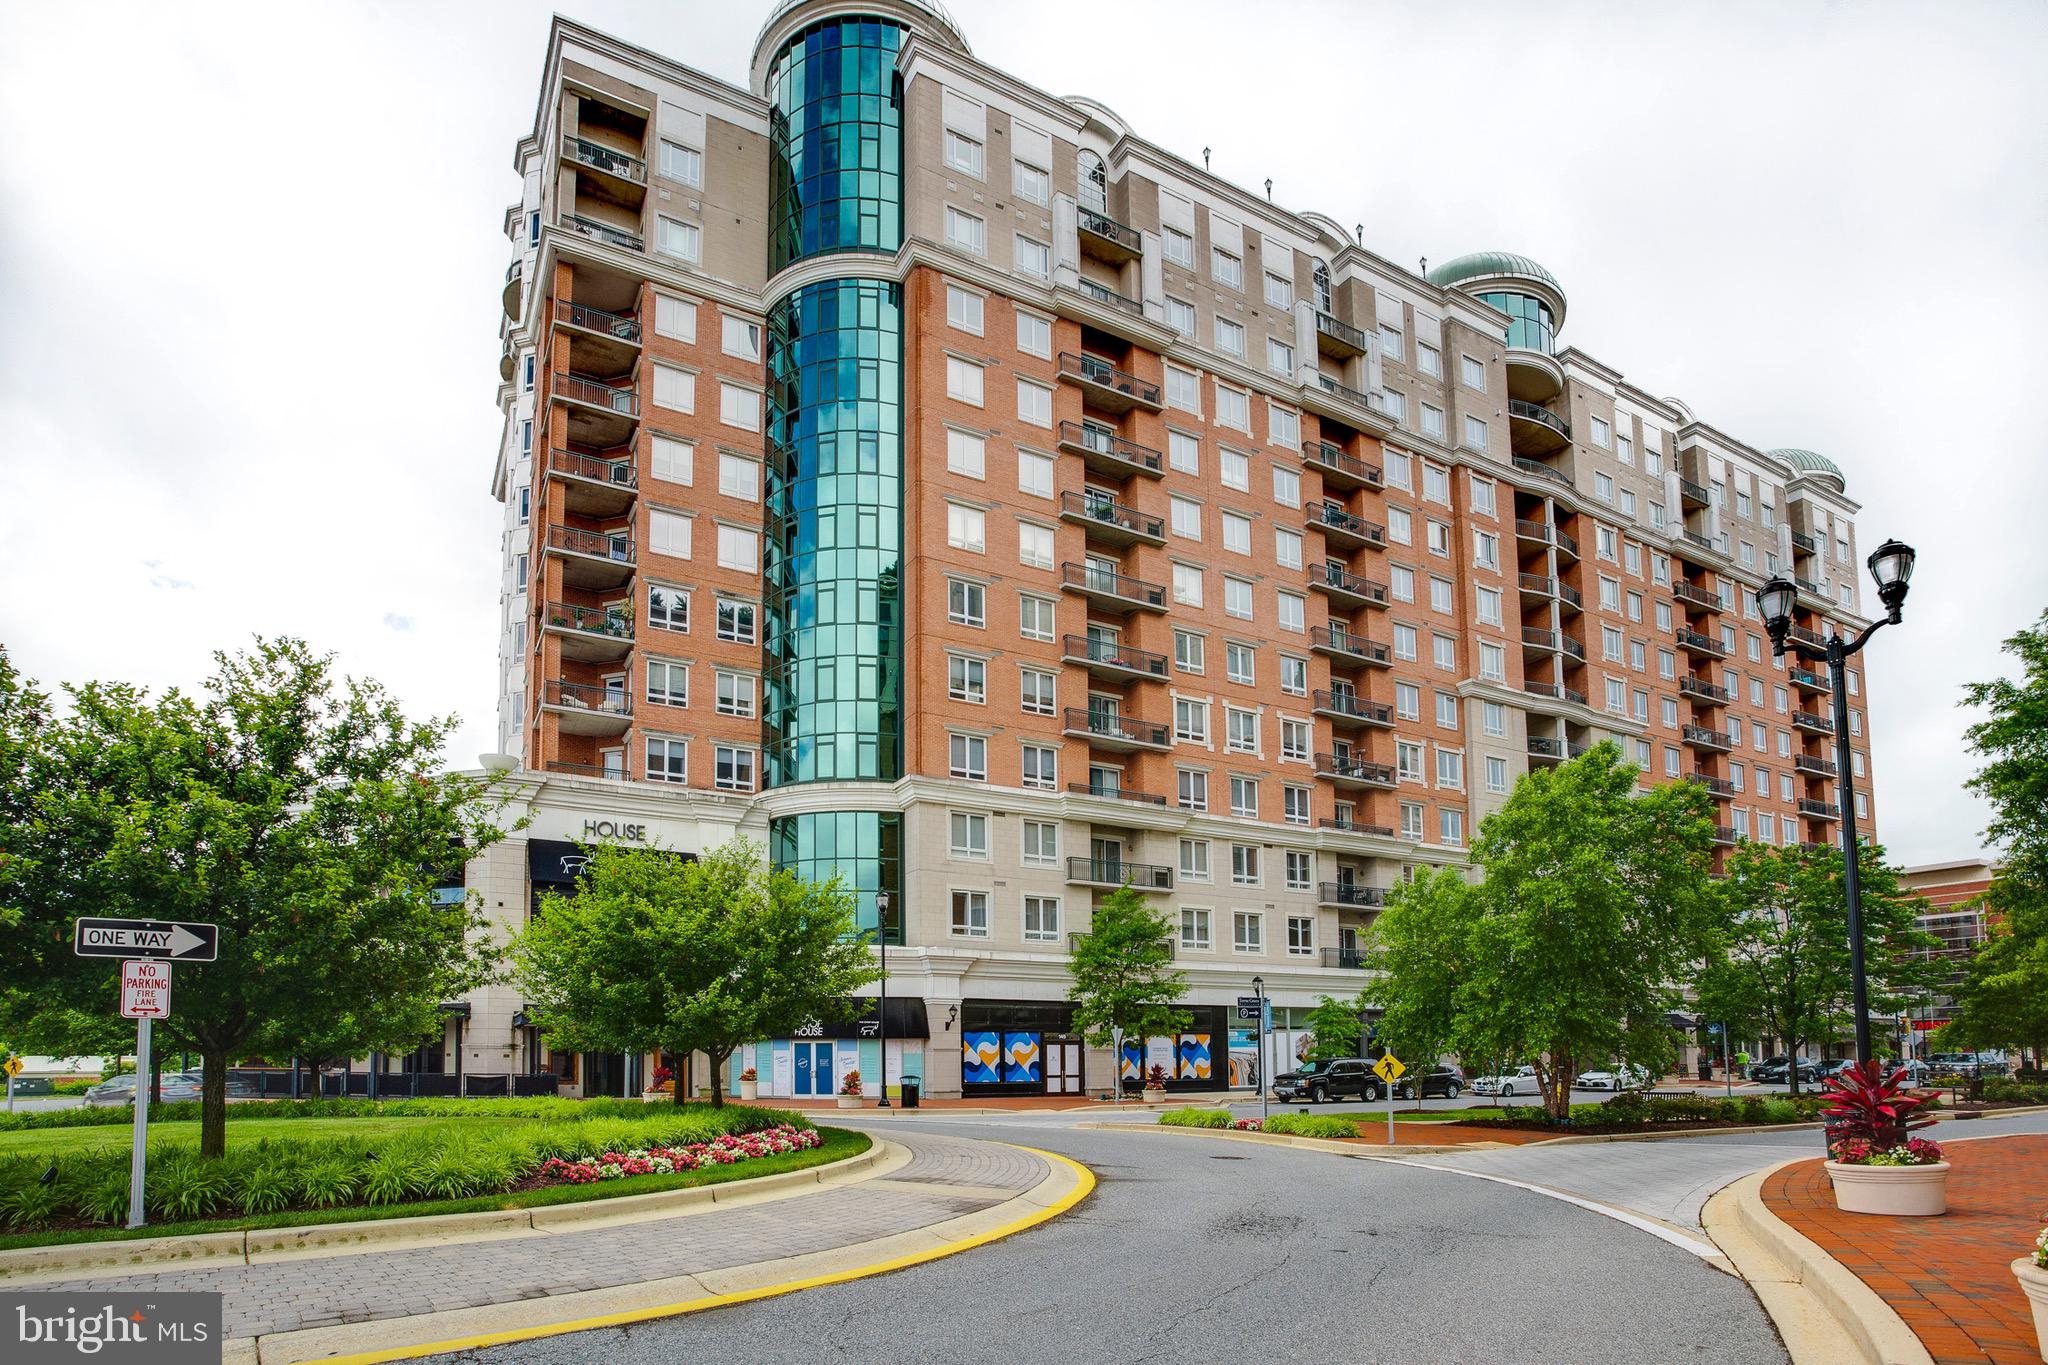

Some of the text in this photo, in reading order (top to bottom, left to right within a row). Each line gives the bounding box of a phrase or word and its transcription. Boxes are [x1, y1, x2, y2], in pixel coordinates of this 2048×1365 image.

[584, 819, 646, 842] HOUSE
[89, 930, 172, 947] ONE WAY
[138, 966, 156, 977] NO
[126, 978, 167, 990] PARKING
[137, 990, 156, 998] FIRE
[134, 998, 157, 1006] LANE
[794, 1027, 824, 1037] HOUSE
